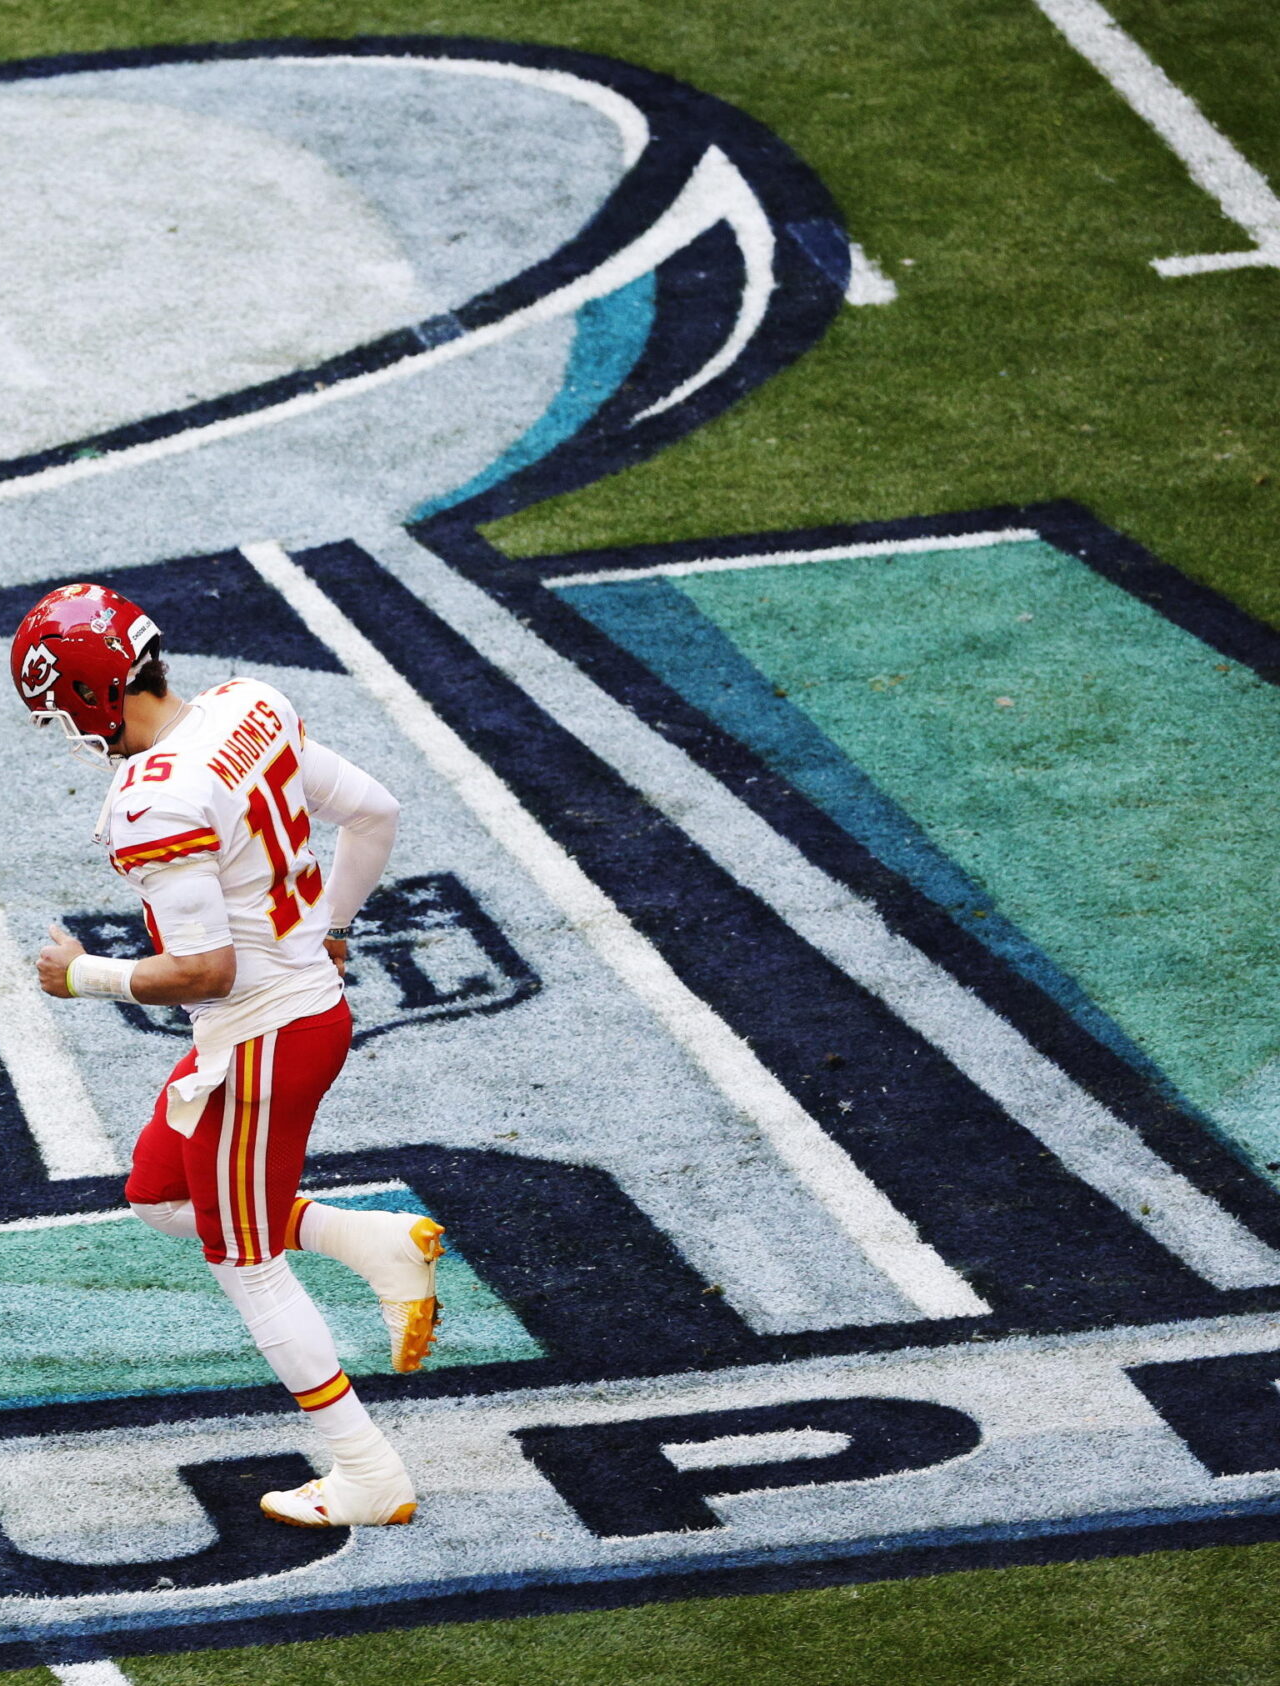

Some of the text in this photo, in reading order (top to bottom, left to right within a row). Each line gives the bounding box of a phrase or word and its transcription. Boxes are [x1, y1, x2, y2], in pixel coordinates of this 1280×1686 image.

[119, 752, 177, 793] 15
[206, 700, 283, 791] MAHOMES
[244, 740, 324, 942] 15
